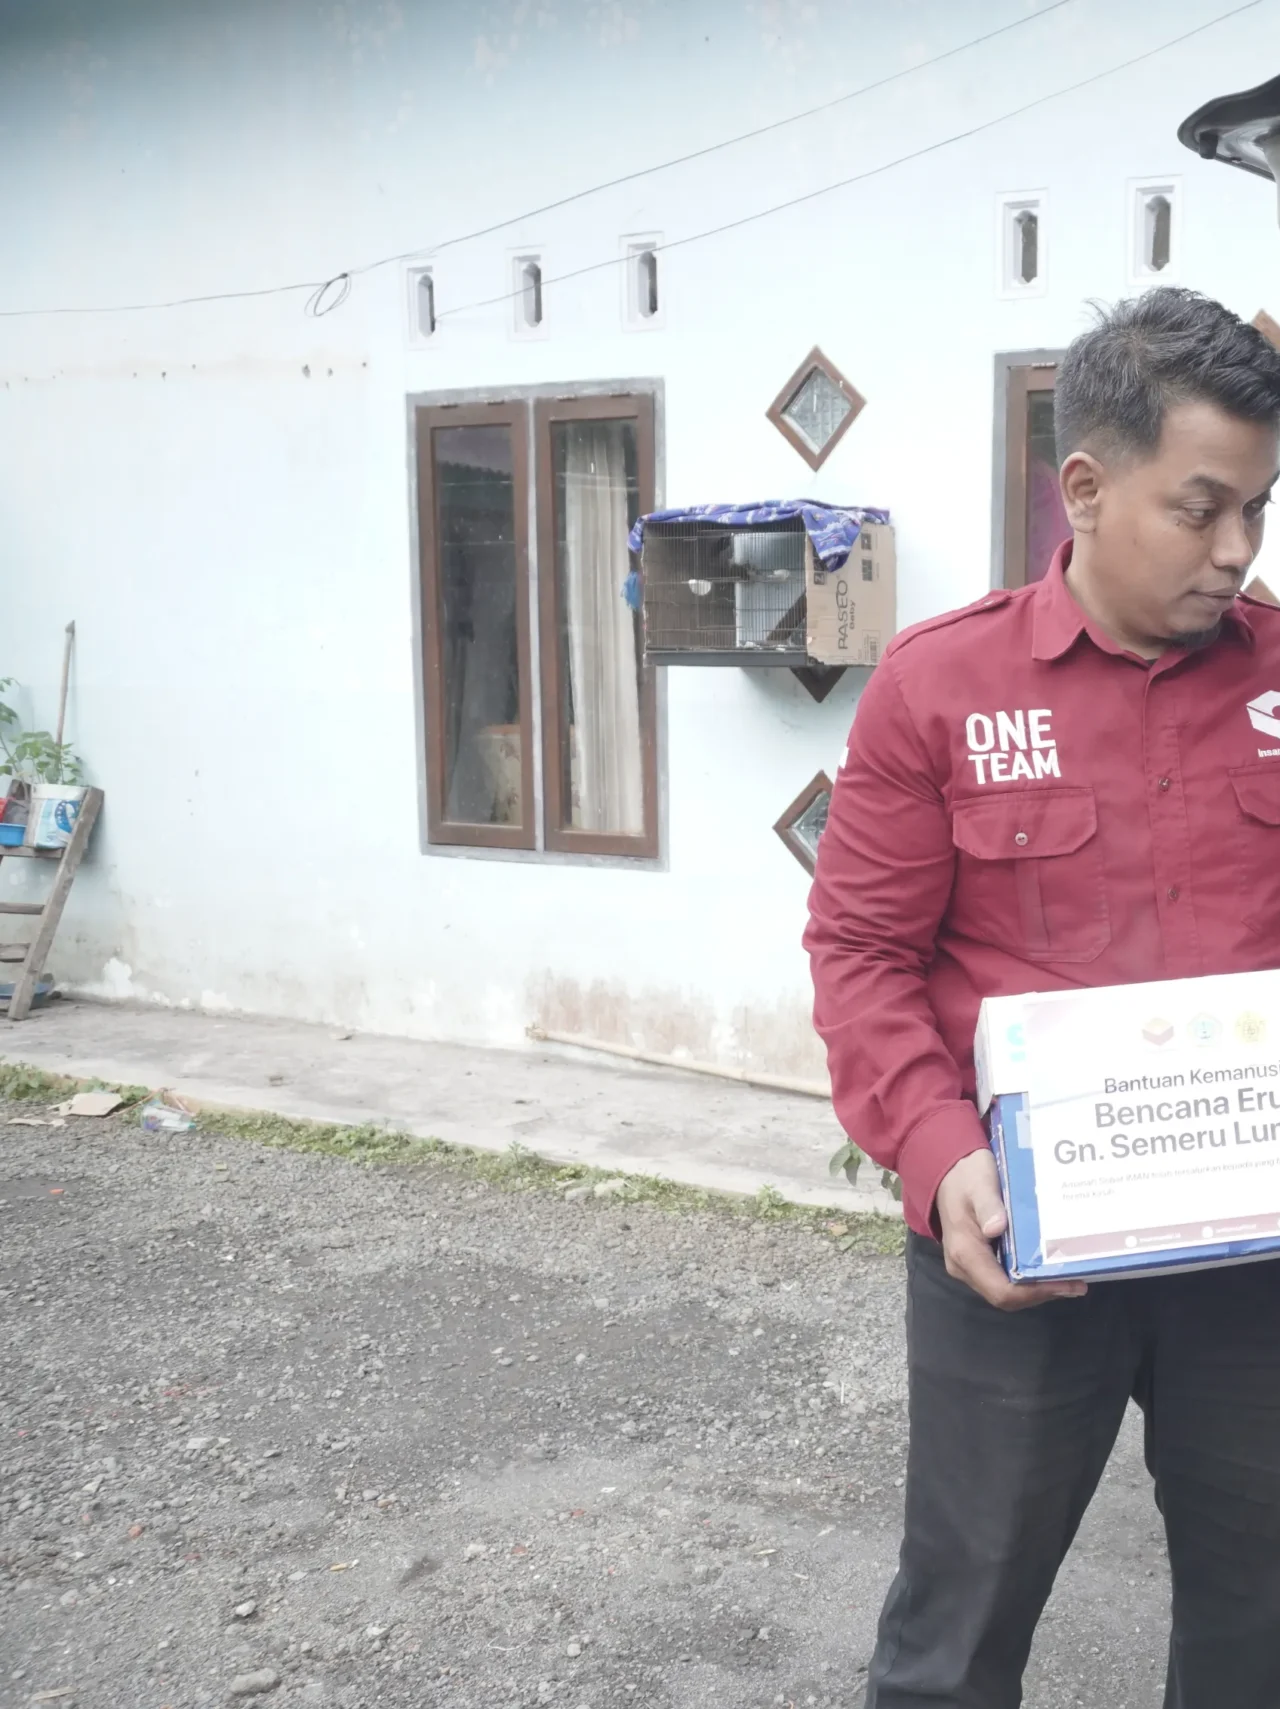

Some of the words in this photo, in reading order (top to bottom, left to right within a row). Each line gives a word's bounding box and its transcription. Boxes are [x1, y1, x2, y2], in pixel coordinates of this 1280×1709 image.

[836, 579, 848, 650] PASEO
[849, 600, 857, 630] Baby
[965, 708, 1057, 753] ONE
[967, 746, 1062, 785] TEAM
[1104, 1074, 1185, 1094] Bantuan
[1094, 1095, 1230, 1128] Bencana
[1053, 1139, 1105, 1165] Gn.
[1110, 1128, 1227, 1159] Semeru
